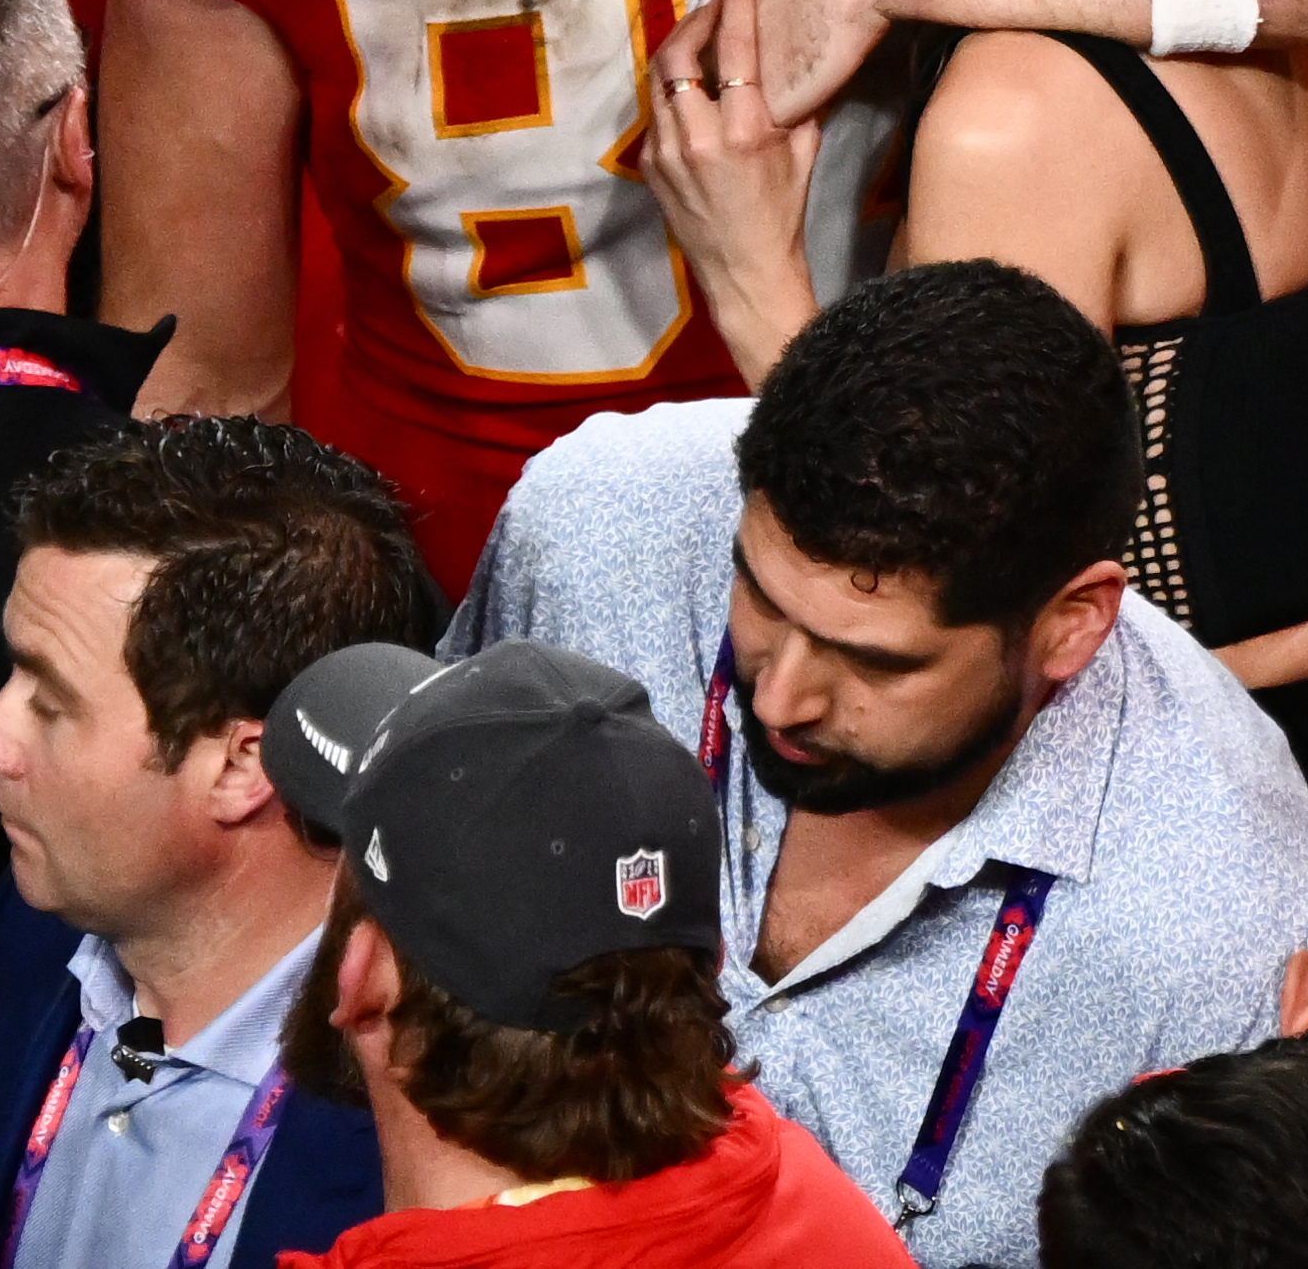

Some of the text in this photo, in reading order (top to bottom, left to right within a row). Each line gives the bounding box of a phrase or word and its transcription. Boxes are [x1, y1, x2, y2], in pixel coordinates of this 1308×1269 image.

[704, 686, 719, 768] GAMEDAY
[623, 877, 661, 909] NFL
[985, 923, 1020, 997] GAMEDAY
[34, 1066, 69, 1145] GAMEDAY
[193, 1166, 237, 1244] GAMEDAY
